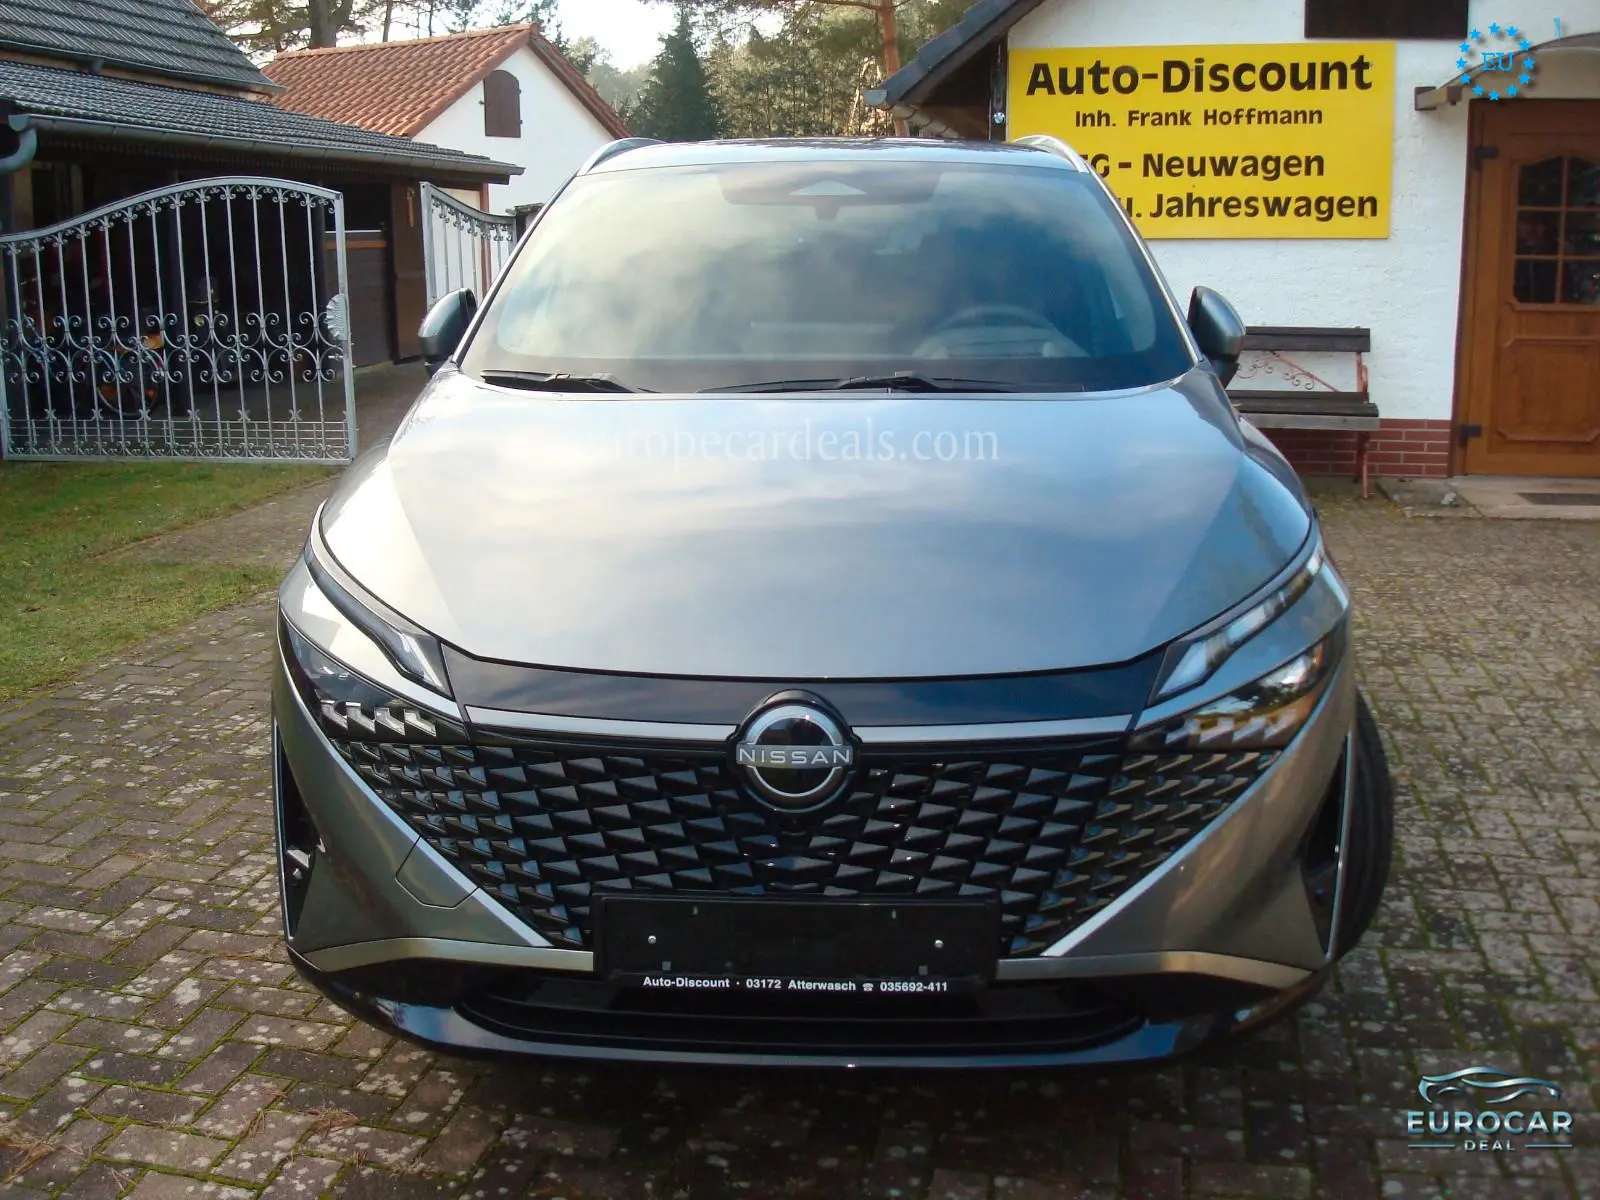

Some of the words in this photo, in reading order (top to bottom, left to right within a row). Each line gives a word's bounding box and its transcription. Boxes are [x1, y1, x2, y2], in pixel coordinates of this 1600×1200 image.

[1026, 54, 1373, 96] Auto-Discount
[1075, 110, 1117, 127] Inh.
[1128, 110, 1192, 127] Frank
[1203, 108, 1323, 126] Hoffmann
[1079, 153, 1110, 178] G
[1143, 153, 1324, 182] Neuwagen
[1149, 192, 1378, 222] Jahreswagen
[739, 748, 850, 765] NISSAN
[643, 976, 730, 988] Auto-Discount
[746, 978, 782, 989] 03172
[788, 979, 857, 991] Atterwasch
[880, 981, 948, 992] 035692-411
